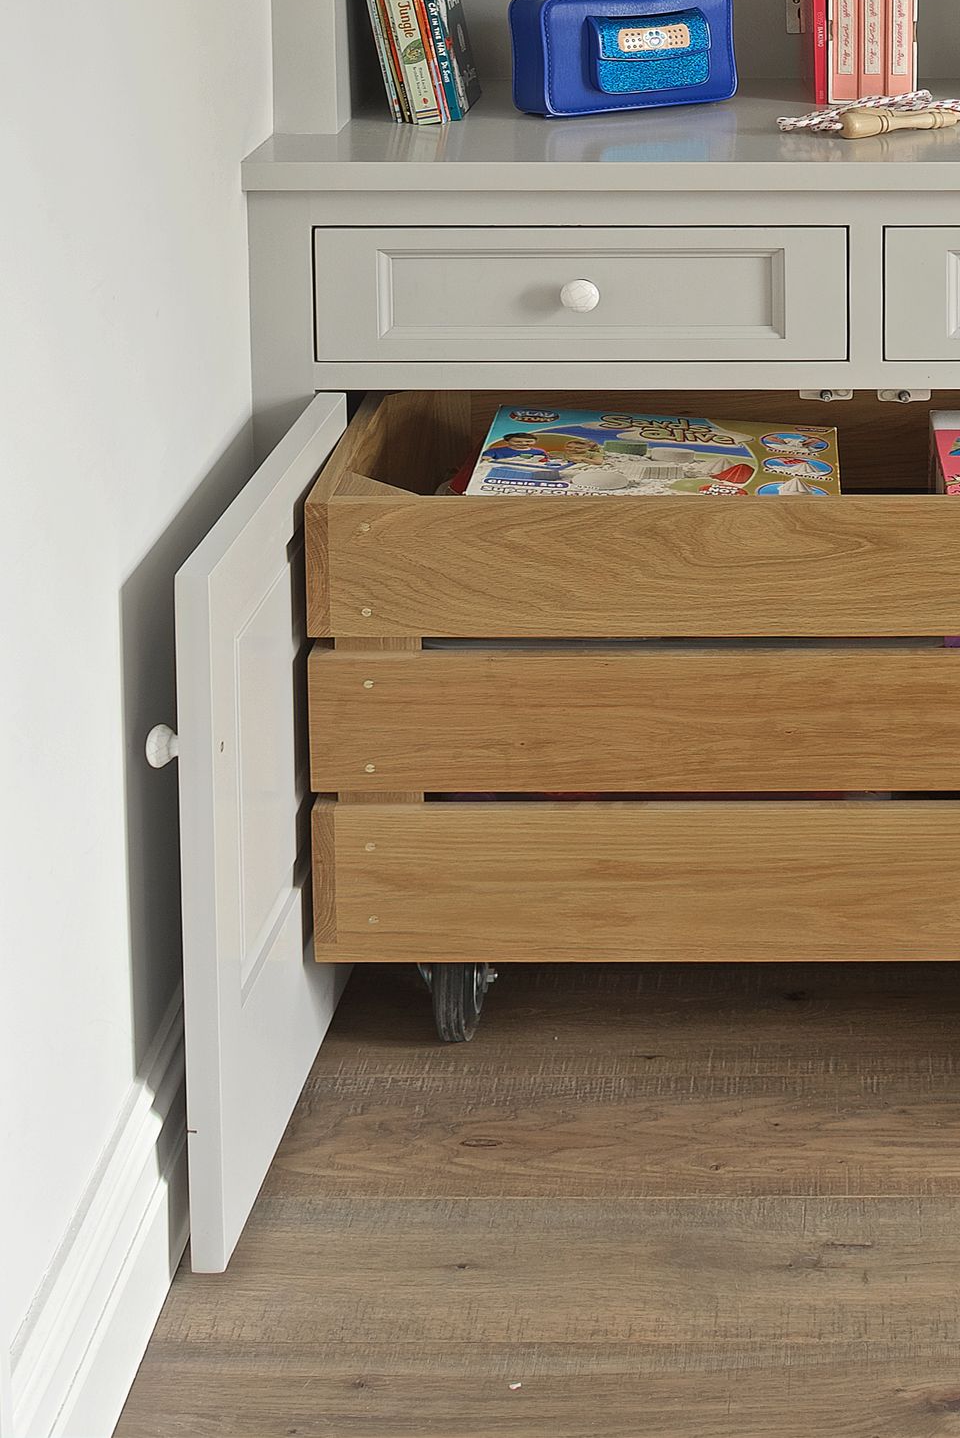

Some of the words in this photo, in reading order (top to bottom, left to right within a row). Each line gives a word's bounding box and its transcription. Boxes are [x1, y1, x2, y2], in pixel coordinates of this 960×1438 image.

[427, 2, 438, 17] CAT
[396, 0, 416, 39] Jungle
[431, 18, 438, 26] IN
[433, 27, 441, 40] THE
[436, 41, 446, 57] HAT
[600, 414, 712, 432] Sands
